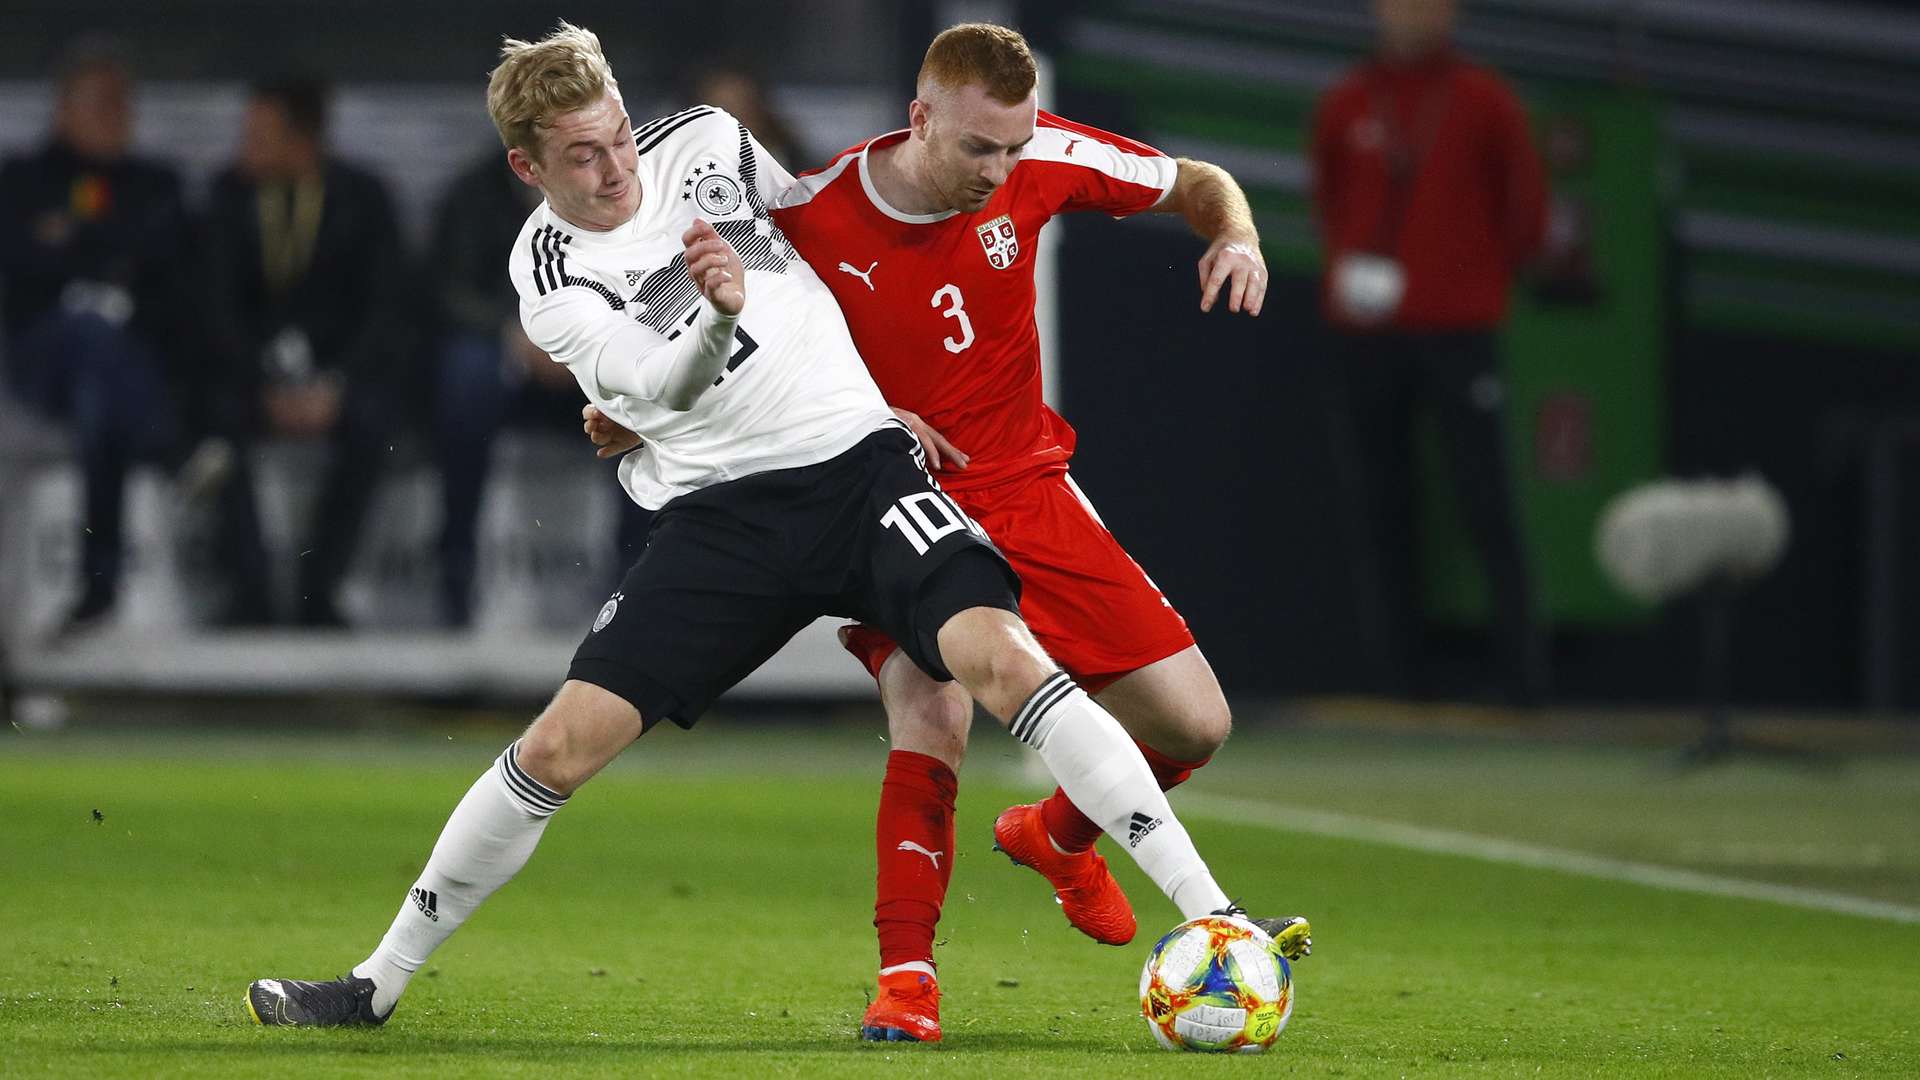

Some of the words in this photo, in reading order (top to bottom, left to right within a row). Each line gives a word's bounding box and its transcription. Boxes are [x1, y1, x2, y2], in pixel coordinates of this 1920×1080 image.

[930, 283, 975, 354] 3
[880, 491, 967, 556] 10
[1129, 818, 1163, 848] adidas
[410, 888, 439, 922] adidas
